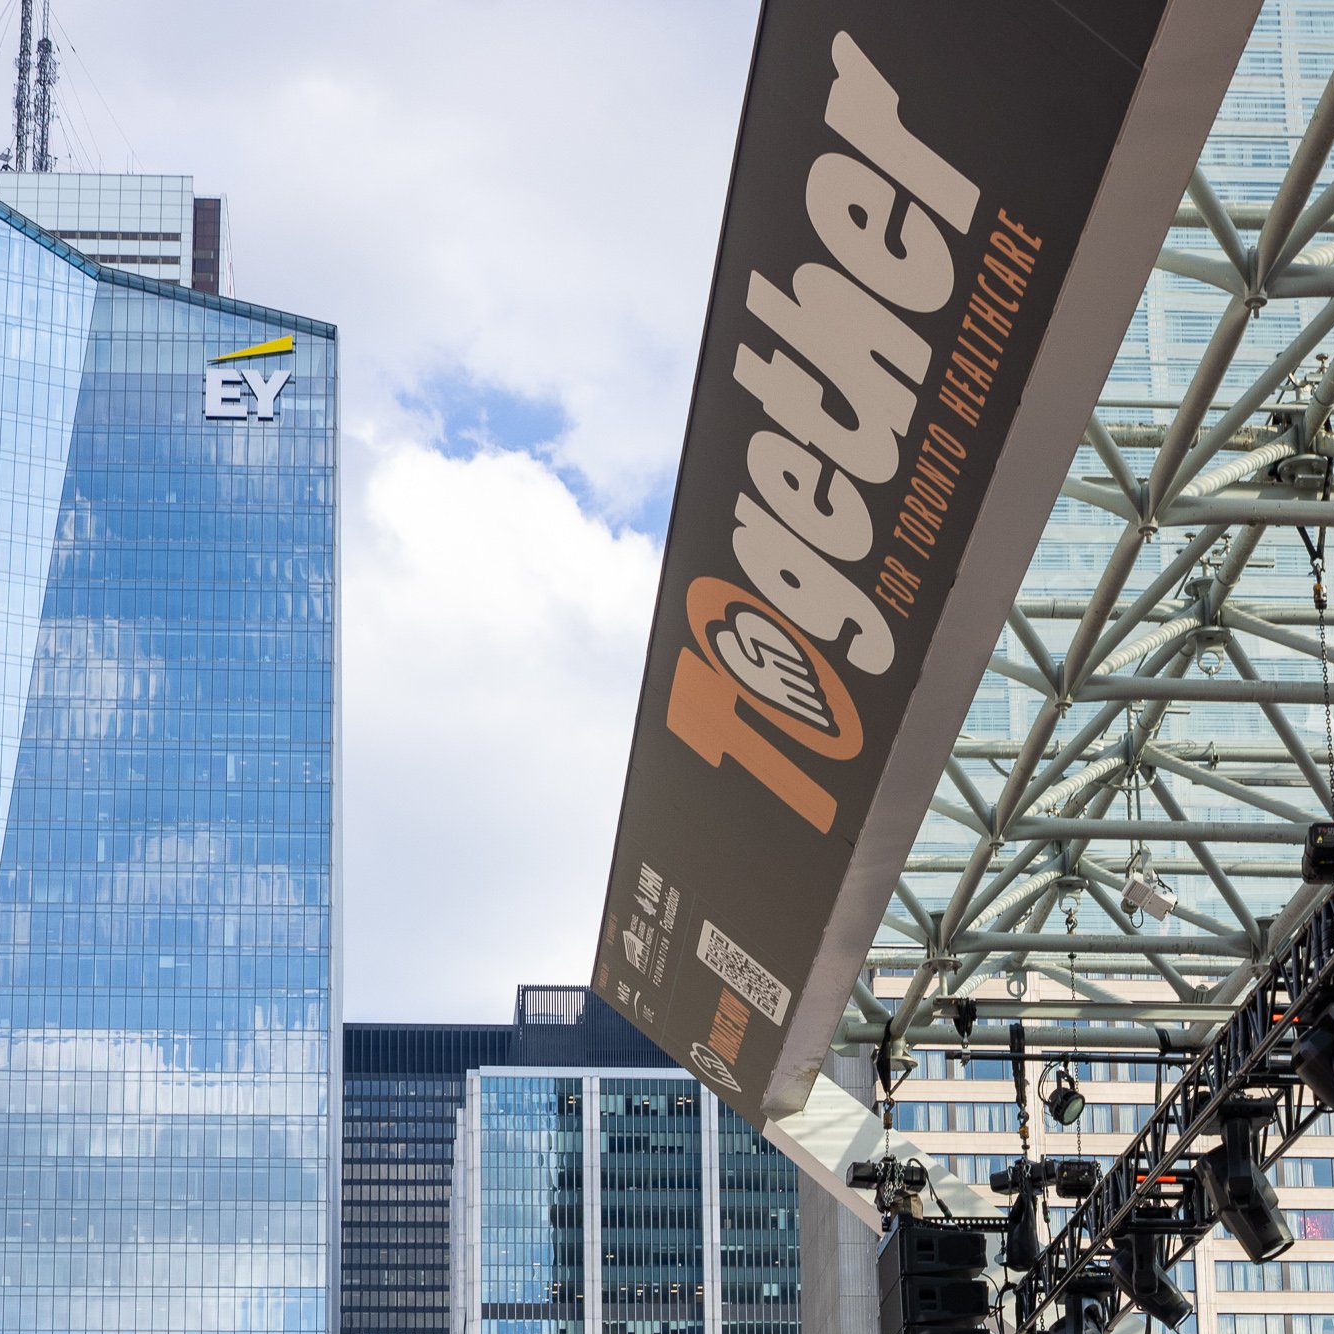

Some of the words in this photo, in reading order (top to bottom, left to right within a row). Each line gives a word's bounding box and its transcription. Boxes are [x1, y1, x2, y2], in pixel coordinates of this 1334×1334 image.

[939, 207, 1044, 428] HEALTHCARE
[205, 369, 292, 421] EY
[894, 422, 967, 560] TORONTO
[875, 555, 921, 618] FOR
[637, 862, 664, 903] UHN
[659, 886, 681, 934] Foundation
[652, 936, 671, 987] FOUNDATION
[616, 980, 631, 1005] MRG
[642, 1004, 655, 1023] LIVE
[717, 987, 751, 1030] NOW
[707, 1011, 744, 1066] DONATE
